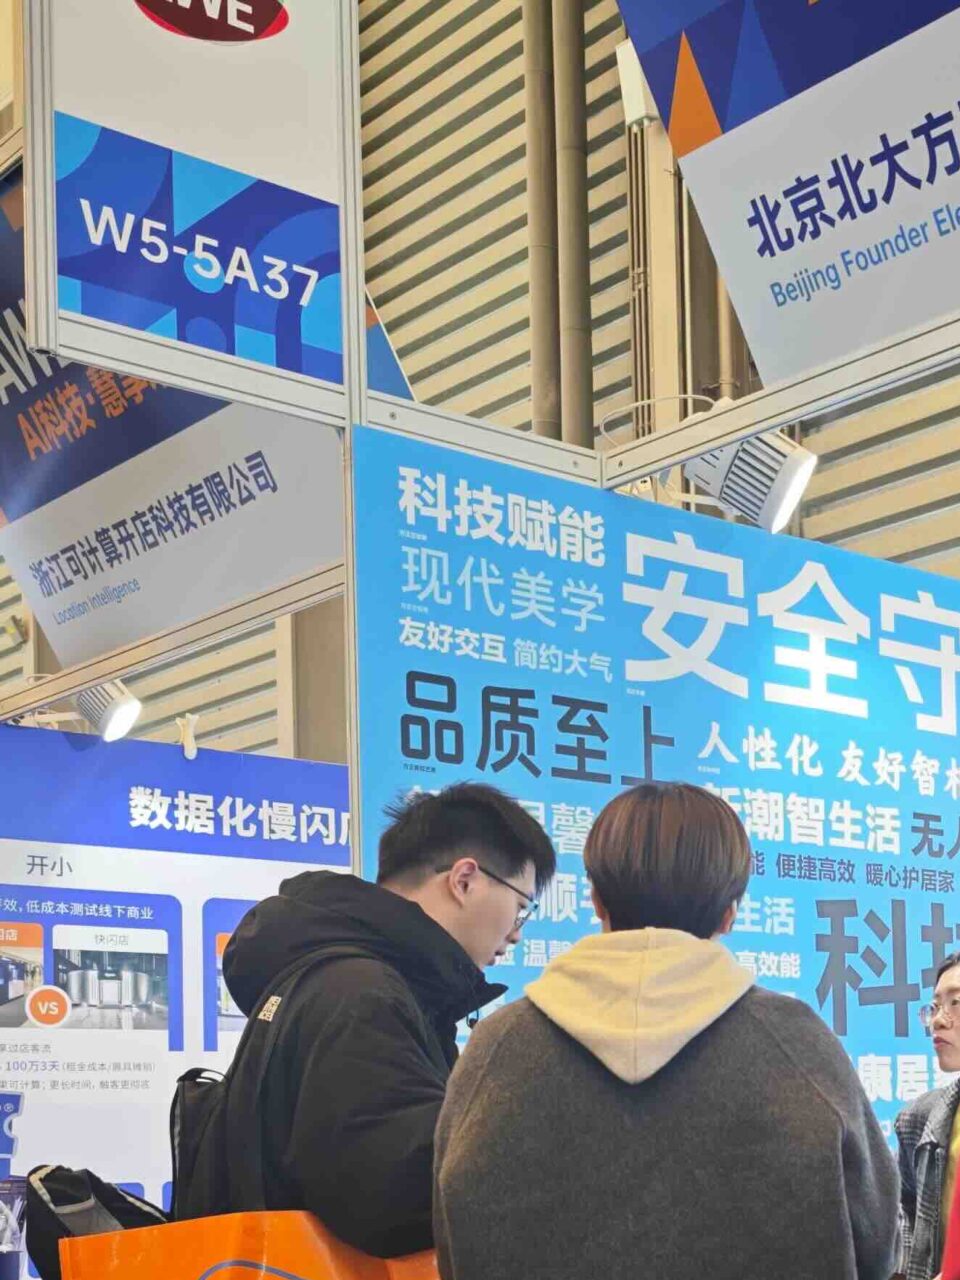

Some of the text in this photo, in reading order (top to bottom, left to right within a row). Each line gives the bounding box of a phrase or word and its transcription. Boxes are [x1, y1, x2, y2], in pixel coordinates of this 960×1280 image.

[80, 198, 319, 306] W5-5A37
[770, 259, 842, 308] Beijing
[842, 219, 930, 278] Founder
[29, 450, 278, 598] 浙江可计算开店科技有限公司
[398, 465, 606, 568] 科技赋能
[53, 578, 141, 625] Location Intelligence
[400, 545, 606, 633] 现代美学
[398, 617, 613, 683] 友好交互 简约大气
[401, 671, 676, 787] 品质至上
[697, 721, 824, 778] 人性化
[26, 854, 73, 878] 开小
[776, 853, 856, 884] 便捷高效
[866, 863, 955, 893] 暖心护居家
[0, 899, 154, 920] 效，低成本测试线下商业
[37, 1001, 59, 1015] VS
